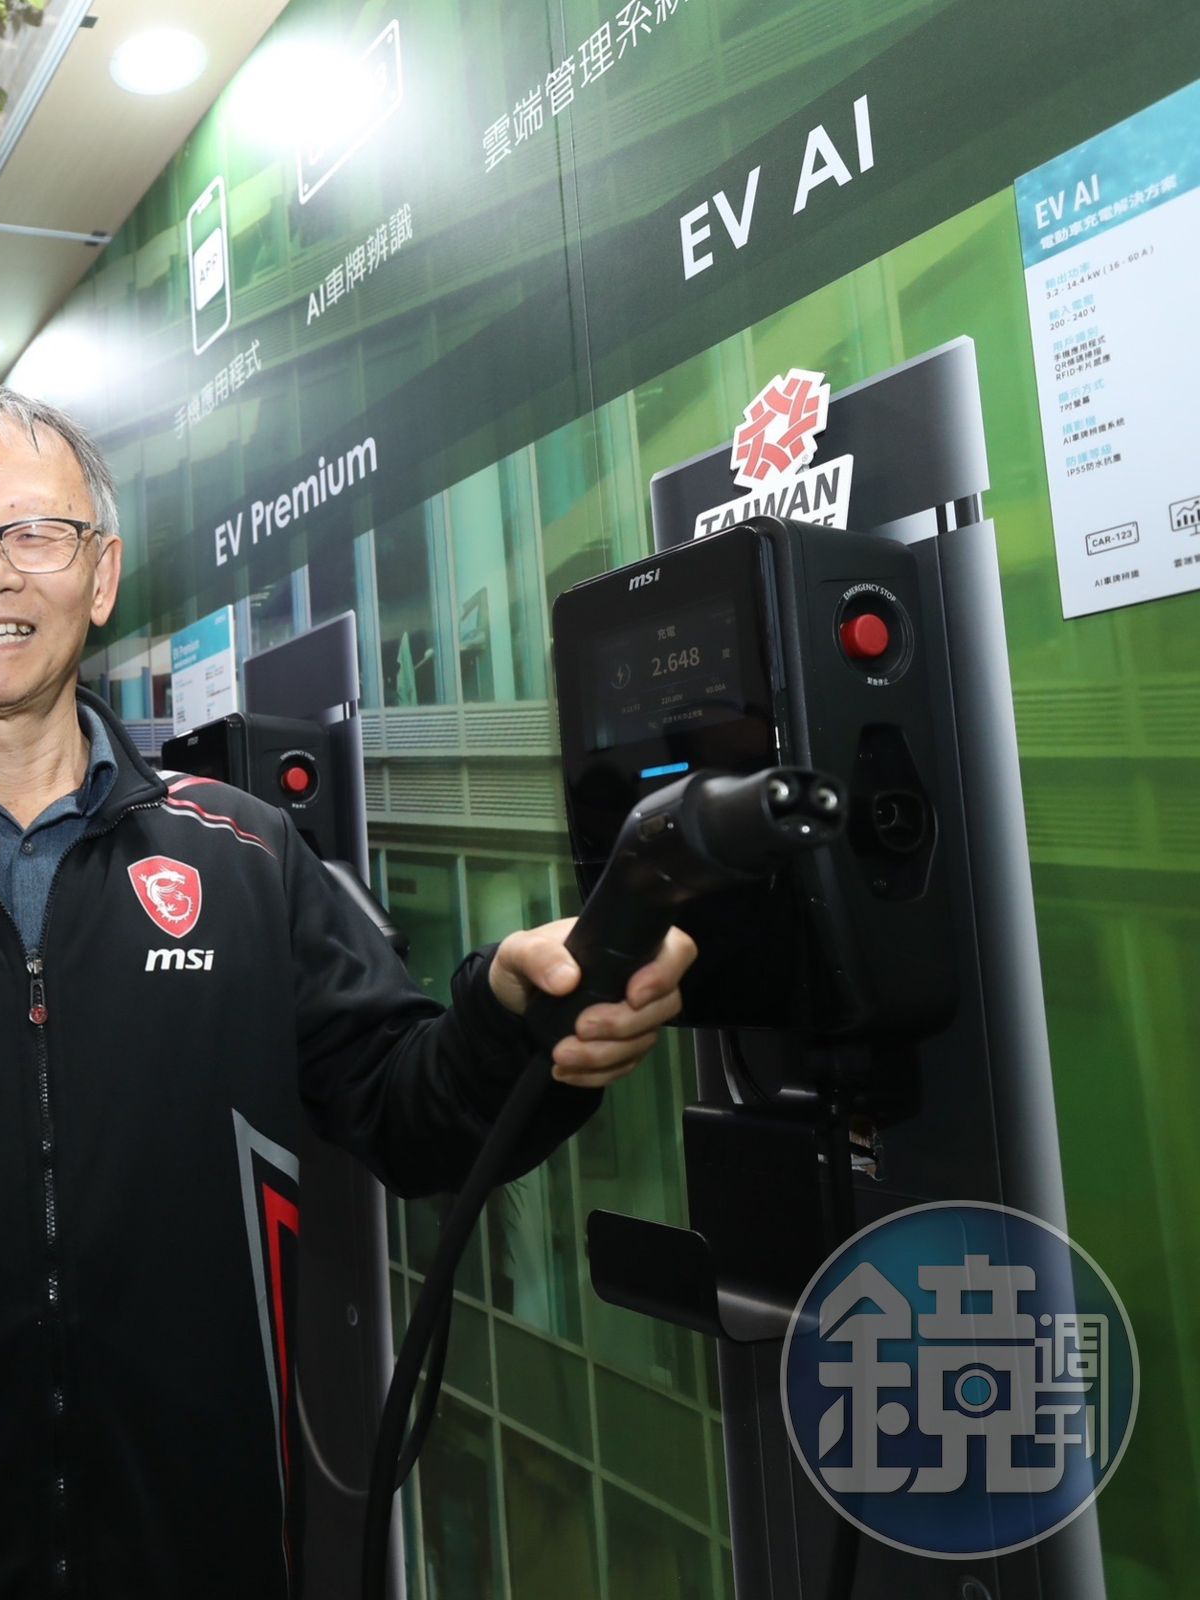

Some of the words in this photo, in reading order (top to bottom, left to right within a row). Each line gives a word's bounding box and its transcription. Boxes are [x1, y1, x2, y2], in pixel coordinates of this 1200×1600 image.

[680, 166, 760, 280] EV
[793, 95, 874, 215] AI
[1035, 190, 1065, 230] EV
[1073, 174, 1100, 212] AI
[1040, 175, 1177, 250] 電動車充電解決方案
[307, 203, 413, 326] AI車牌辨識
[1066, 275, 1086, 290] 14.4
[1050, 318, 1065, 331] 200
[1072, 308, 1089, 321] 240
[215, 512, 243, 567] EV
[251, 437, 377, 545] Premium
[1092, 529, 1133, 548] CAR-123
[629, 567, 660, 591] msi
[843, 583, 880, 601] EMERGENCY
[880, 587, 897, 602] STOP
[651, 646, 701, 677] 2.648
[145, 948, 215, 972] msi
